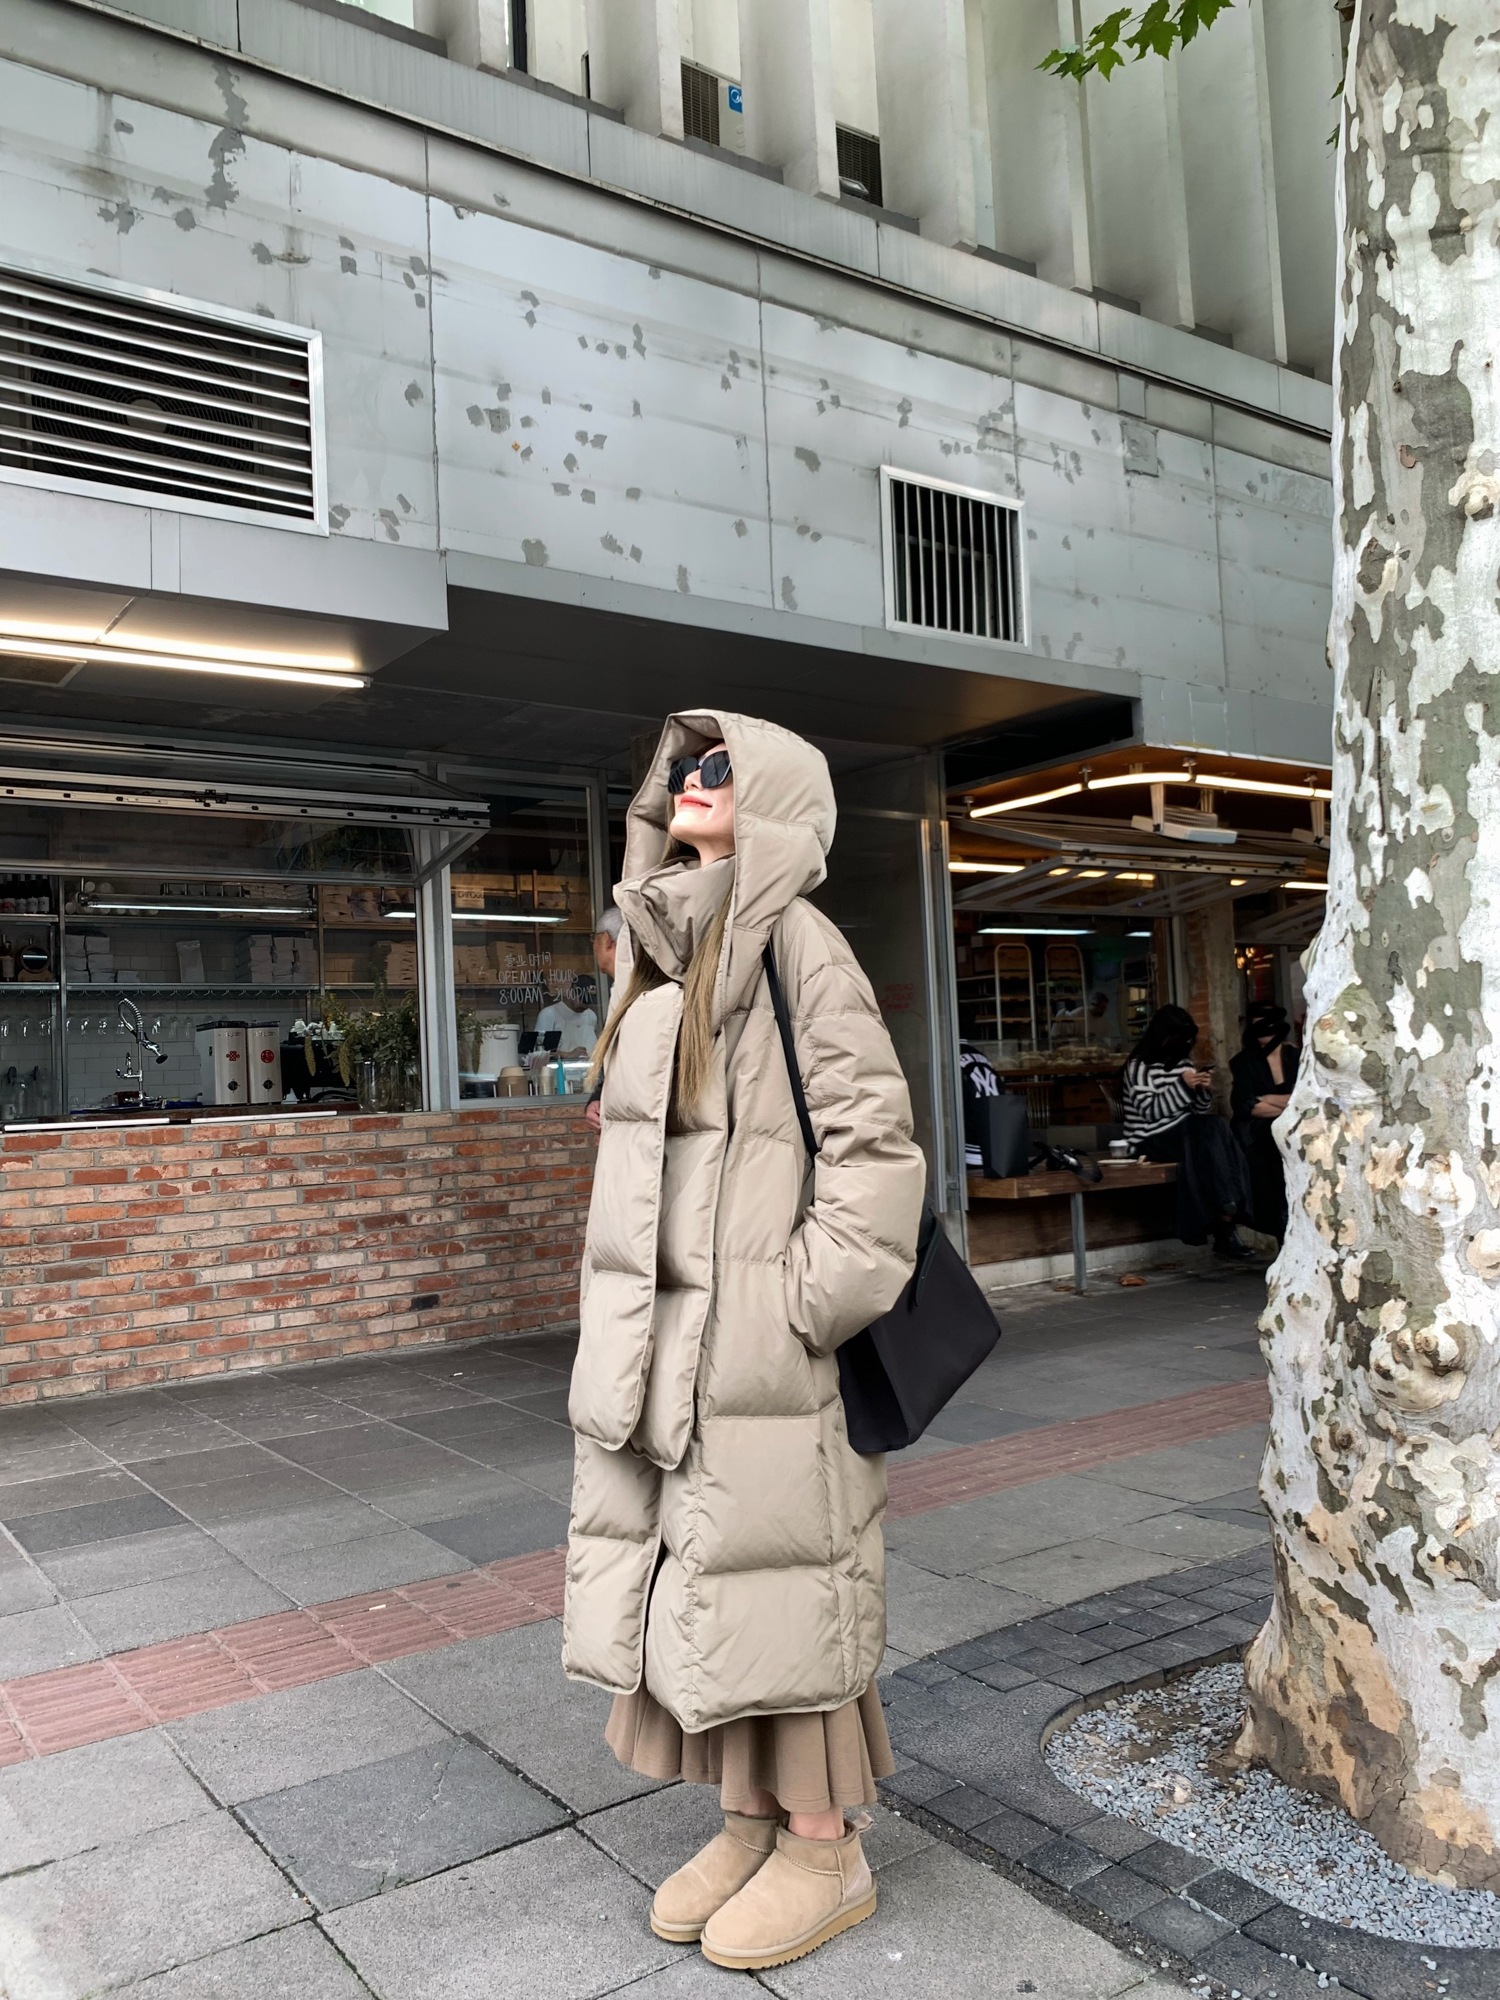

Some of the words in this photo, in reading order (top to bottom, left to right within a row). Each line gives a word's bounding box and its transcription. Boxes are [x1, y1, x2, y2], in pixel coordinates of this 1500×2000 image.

[503, 951, 552, 968] 营业时间
[498, 969, 547, 985] OPENING
[549, 968, 579, 983] HOURS
